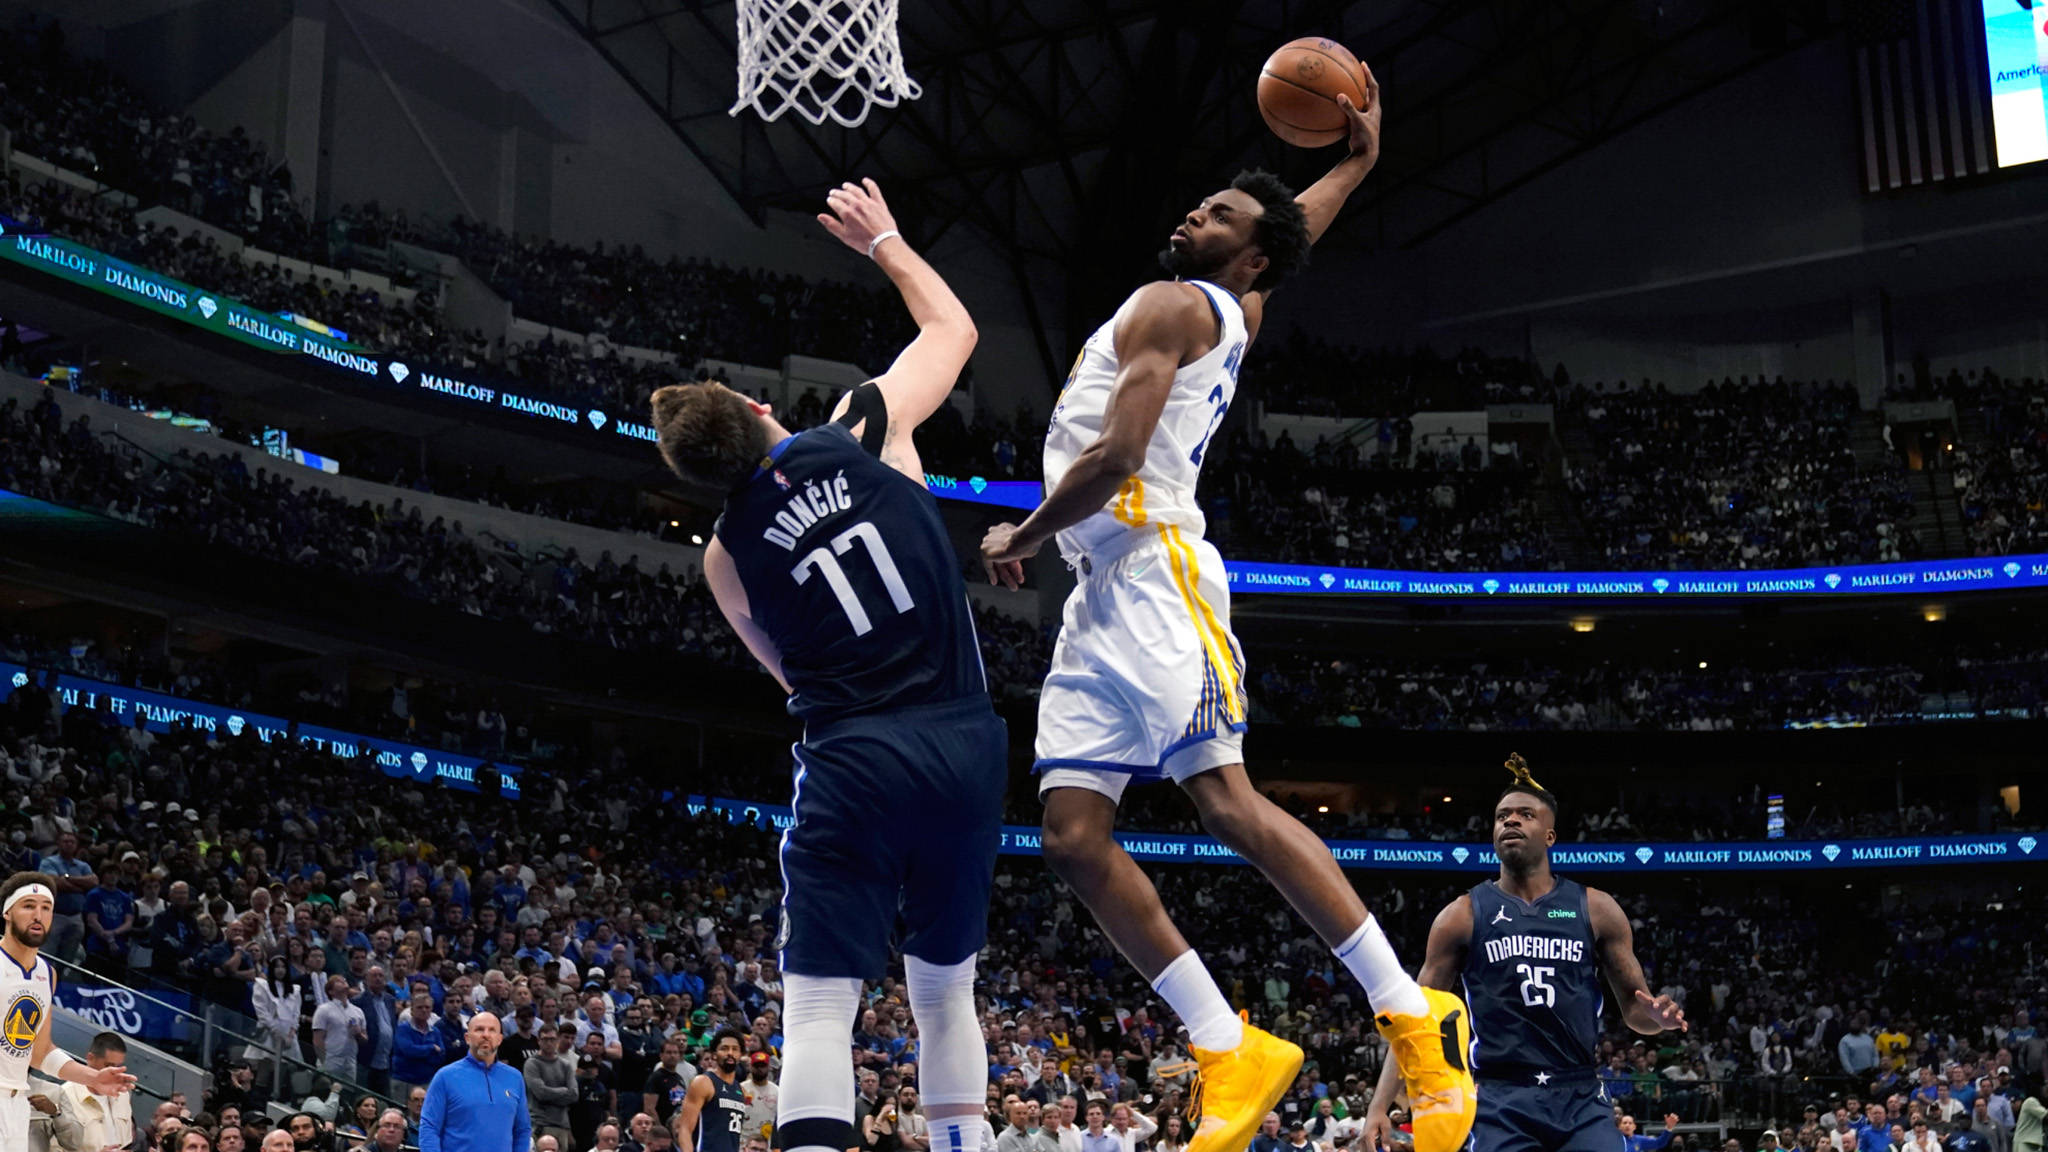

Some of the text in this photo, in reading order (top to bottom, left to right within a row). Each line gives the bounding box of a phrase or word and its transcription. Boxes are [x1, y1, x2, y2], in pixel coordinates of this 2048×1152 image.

[16, 235, 188, 309] MARILOFF DIAMONDS
[227, 311, 379, 376] MARILOFF DIAMONDS
[420, 372, 579, 424] MARILOFF DIAMONDS
[763, 469, 852, 552] DONČIĆ
[790, 521, 915, 637] 77
[1246, 571, 1311, 587] DIAMONDS
[1678, 578, 1816, 594] MARILOFF DIAMONDS
[1851, 567, 1994, 588] MARILOFF DIAMONDS
[1344, 578, 1474, 595] MARILOFF DIAMONDS
[1508, 581, 1644, 594] MARILOFF DIAMONDS
[1123, 840, 1187, 855] MARILOFF
[1332, 847, 1444, 863] ILOFF DIAMONDS
[1663, 848, 1813, 864] MARILOFF DIAMONDS
[1851, 842, 2008, 860] MARILOFF DIAMONDS
[1552, 849, 1626, 865] DIAMONDS
[1547, 909, 1577, 919] chime
[1484, 934, 1584, 963] MAVERICKS
[1516, 963, 1556, 1009] 25
